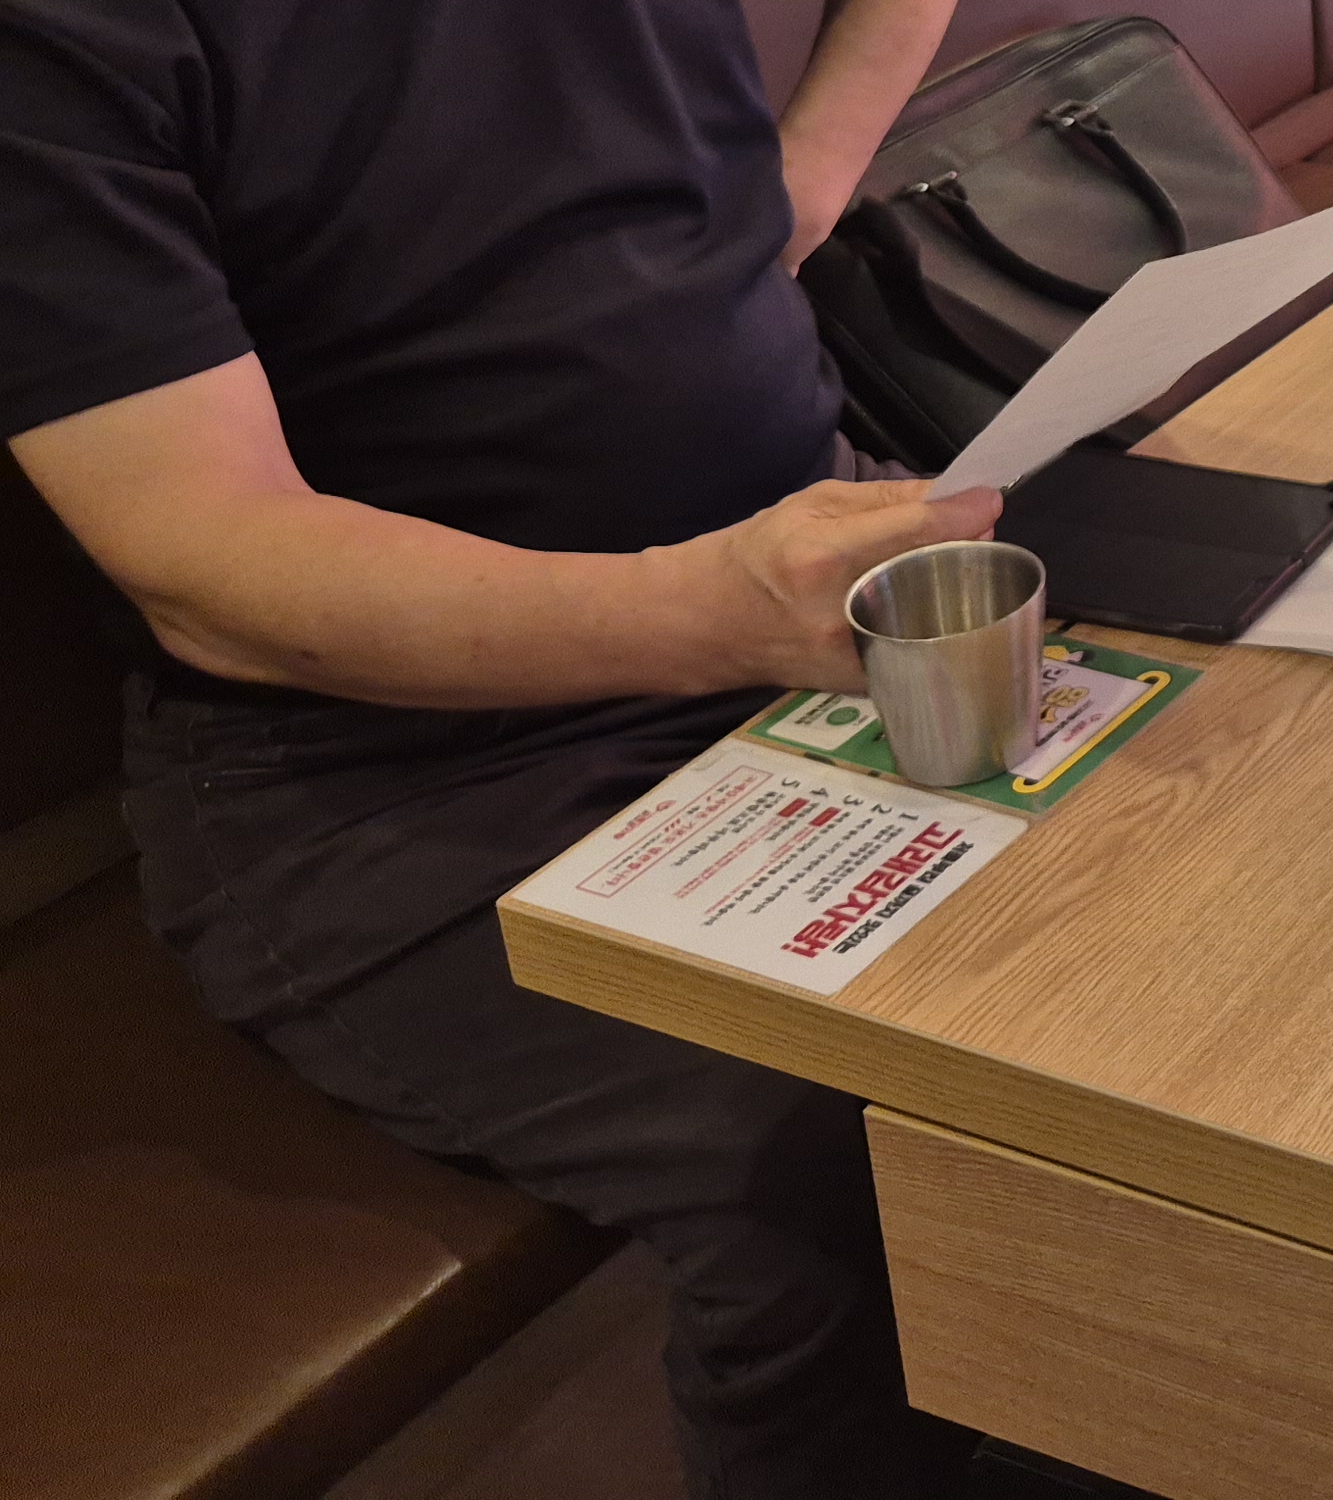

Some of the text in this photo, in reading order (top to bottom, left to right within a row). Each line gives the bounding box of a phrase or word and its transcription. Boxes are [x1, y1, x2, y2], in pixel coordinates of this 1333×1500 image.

[777, 777, 803, 789] 5
[807, 785, 835, 798] 4
[838, 794, 867, 808] 3
[869, 803, 894, 815] 2
[897, 811, 921, 822] 1
[779, 819, 966, 960] 고래감자탕!
